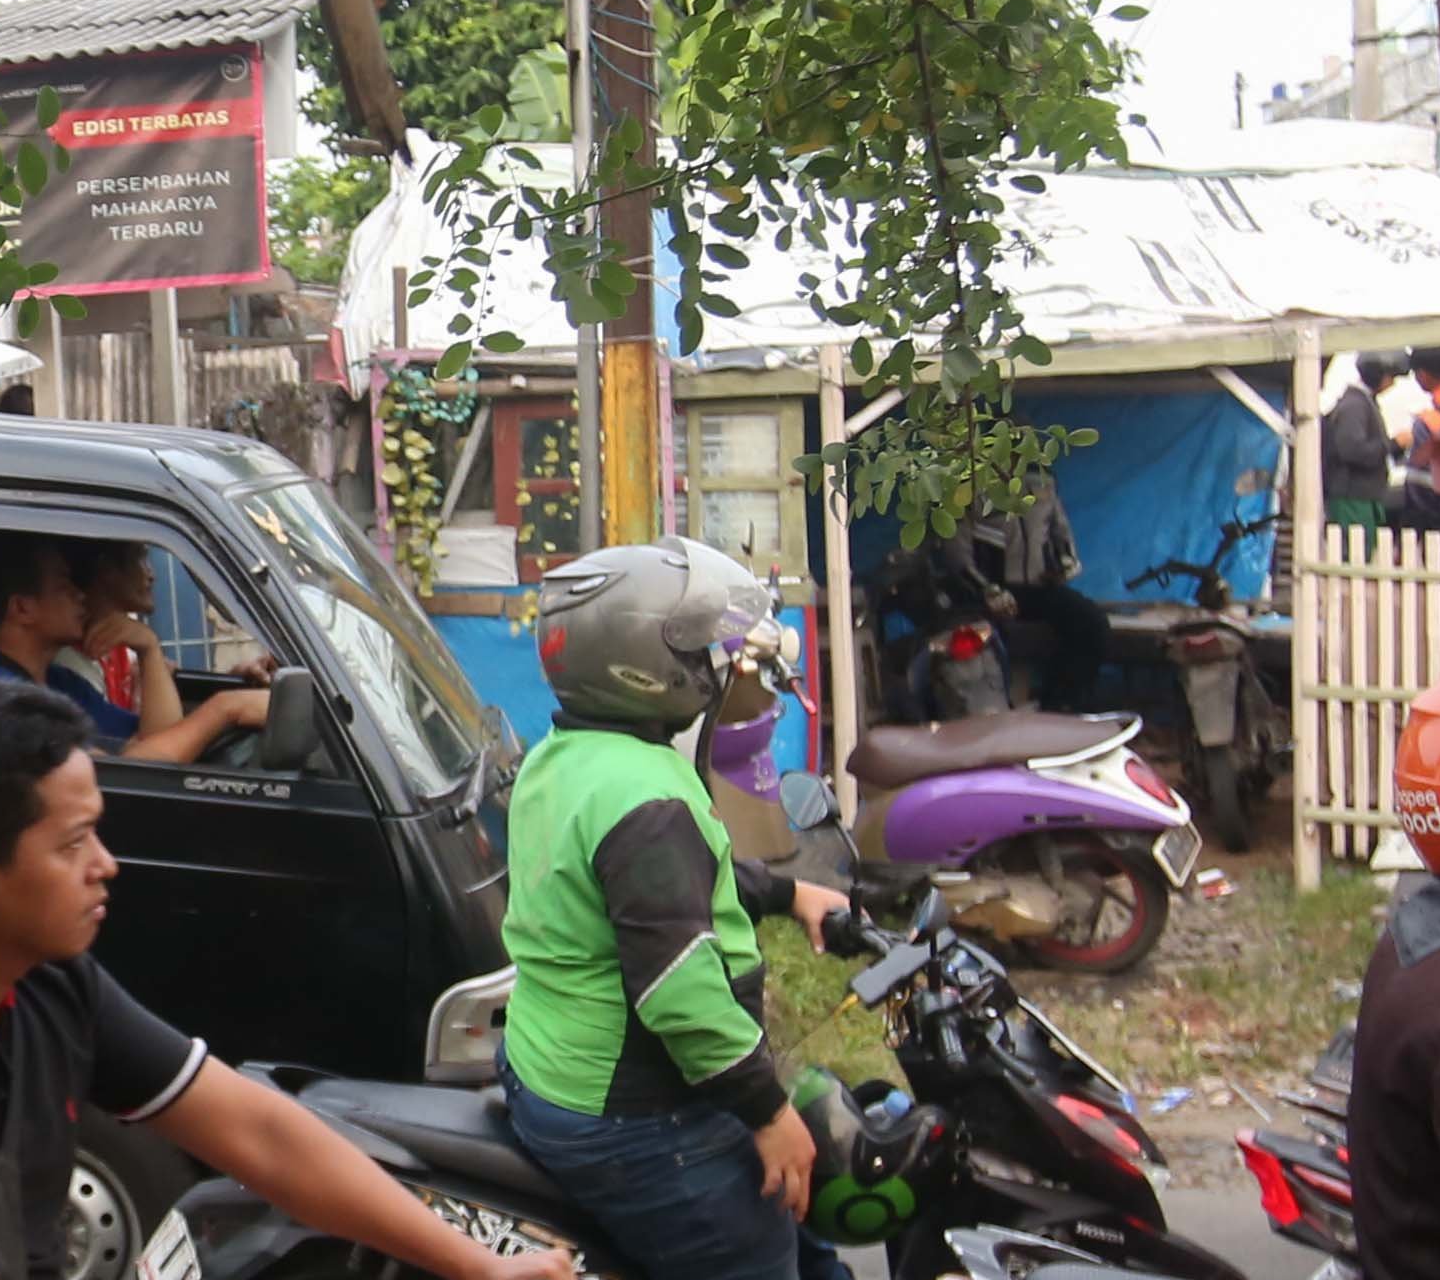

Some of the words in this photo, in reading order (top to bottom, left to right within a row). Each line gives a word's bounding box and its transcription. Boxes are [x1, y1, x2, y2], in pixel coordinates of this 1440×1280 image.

[72, 120, 123, 137] EDISI
[130, 109, 230, 132] TERBATAS
[76, 169, 231, 197] PERSEMBAHAN
[90, 196, 219, 219] MAHAKARYA
[108, 221, 204, 242] TERBARU
[1075, 1221, 1125, 1245] HONDA
